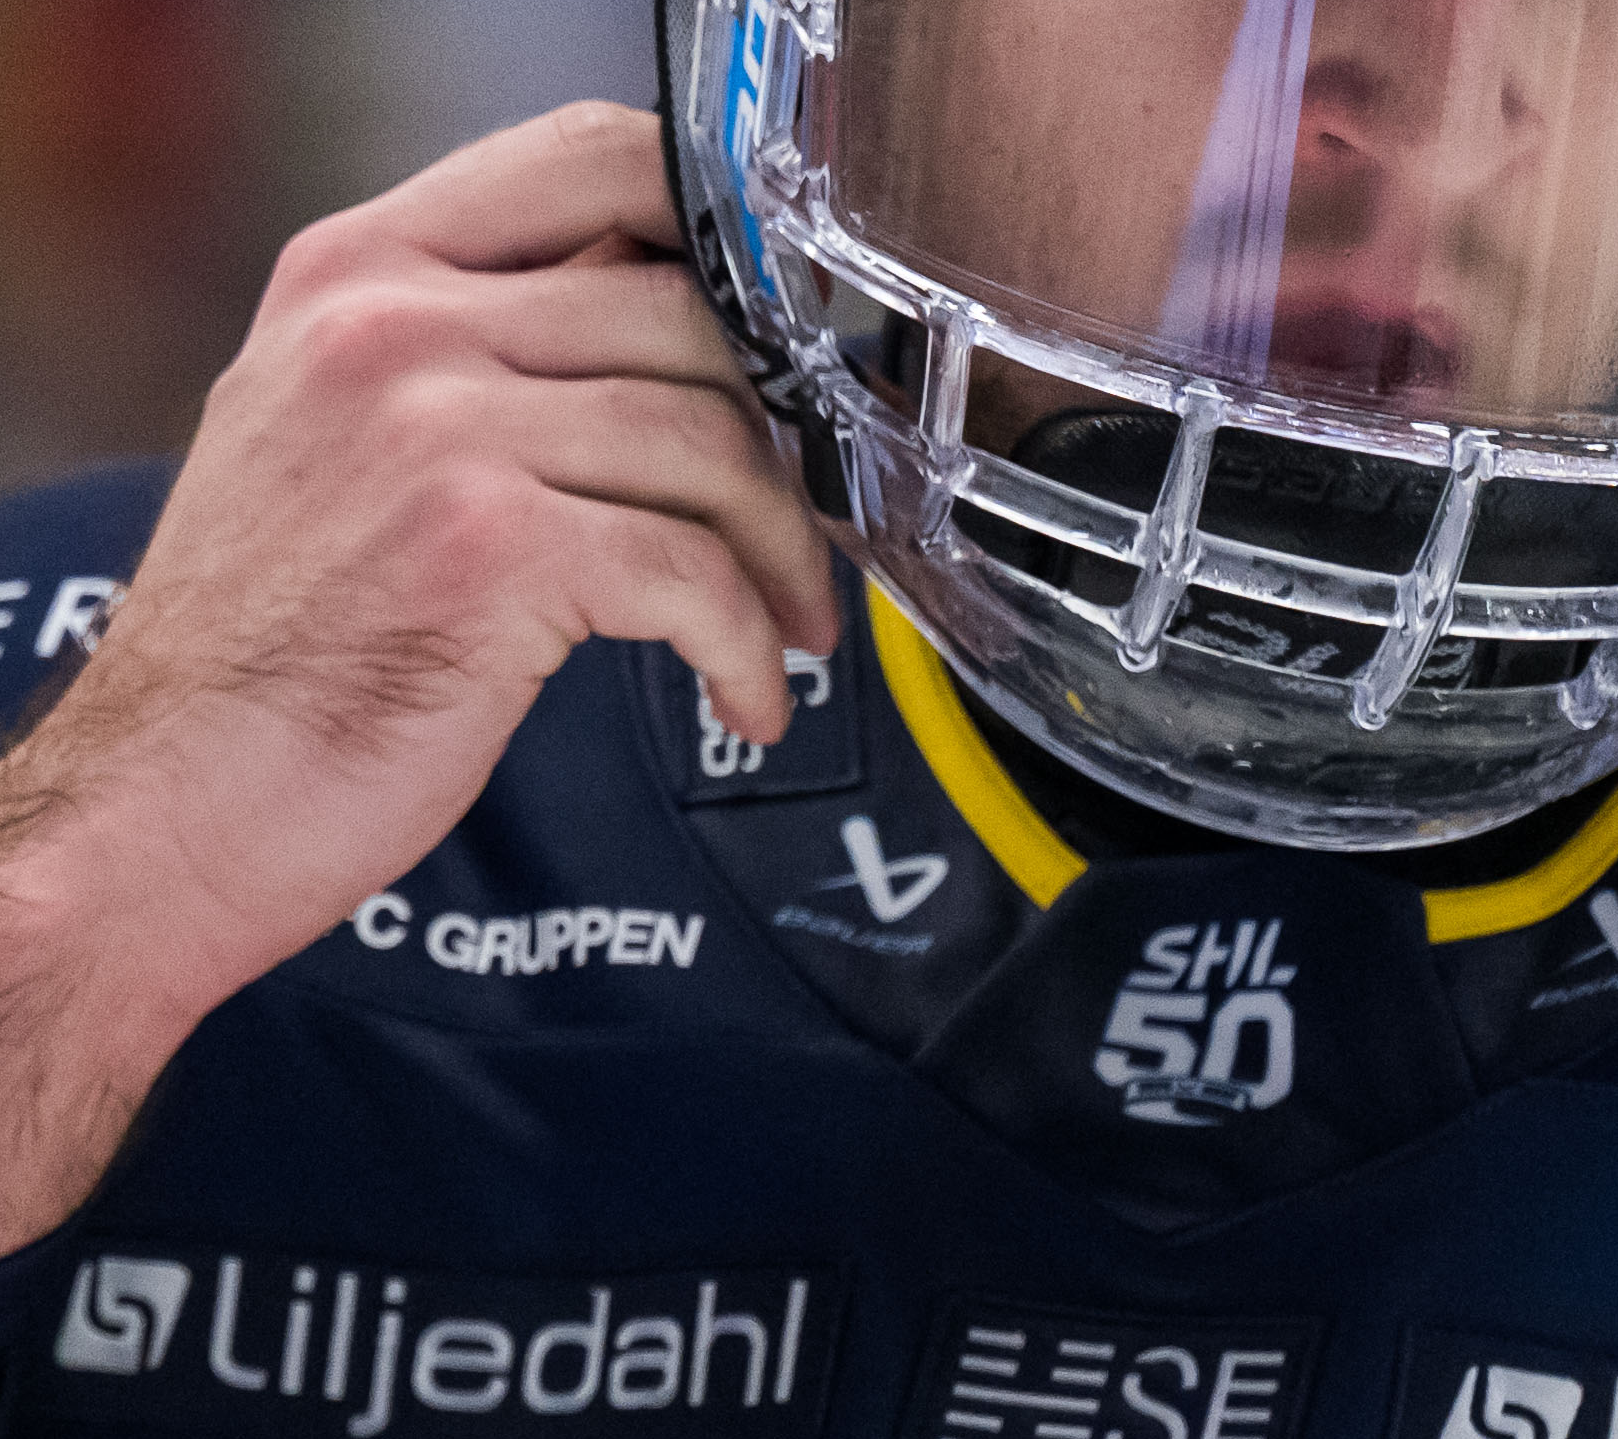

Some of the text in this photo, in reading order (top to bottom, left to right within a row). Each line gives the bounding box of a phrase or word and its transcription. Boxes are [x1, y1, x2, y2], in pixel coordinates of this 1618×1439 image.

[424, 906, 706, 976] GRUPPEN
[1093, 989, 1295, 1125] 50
[208, 1256, 808, 1438] Liljedahl
